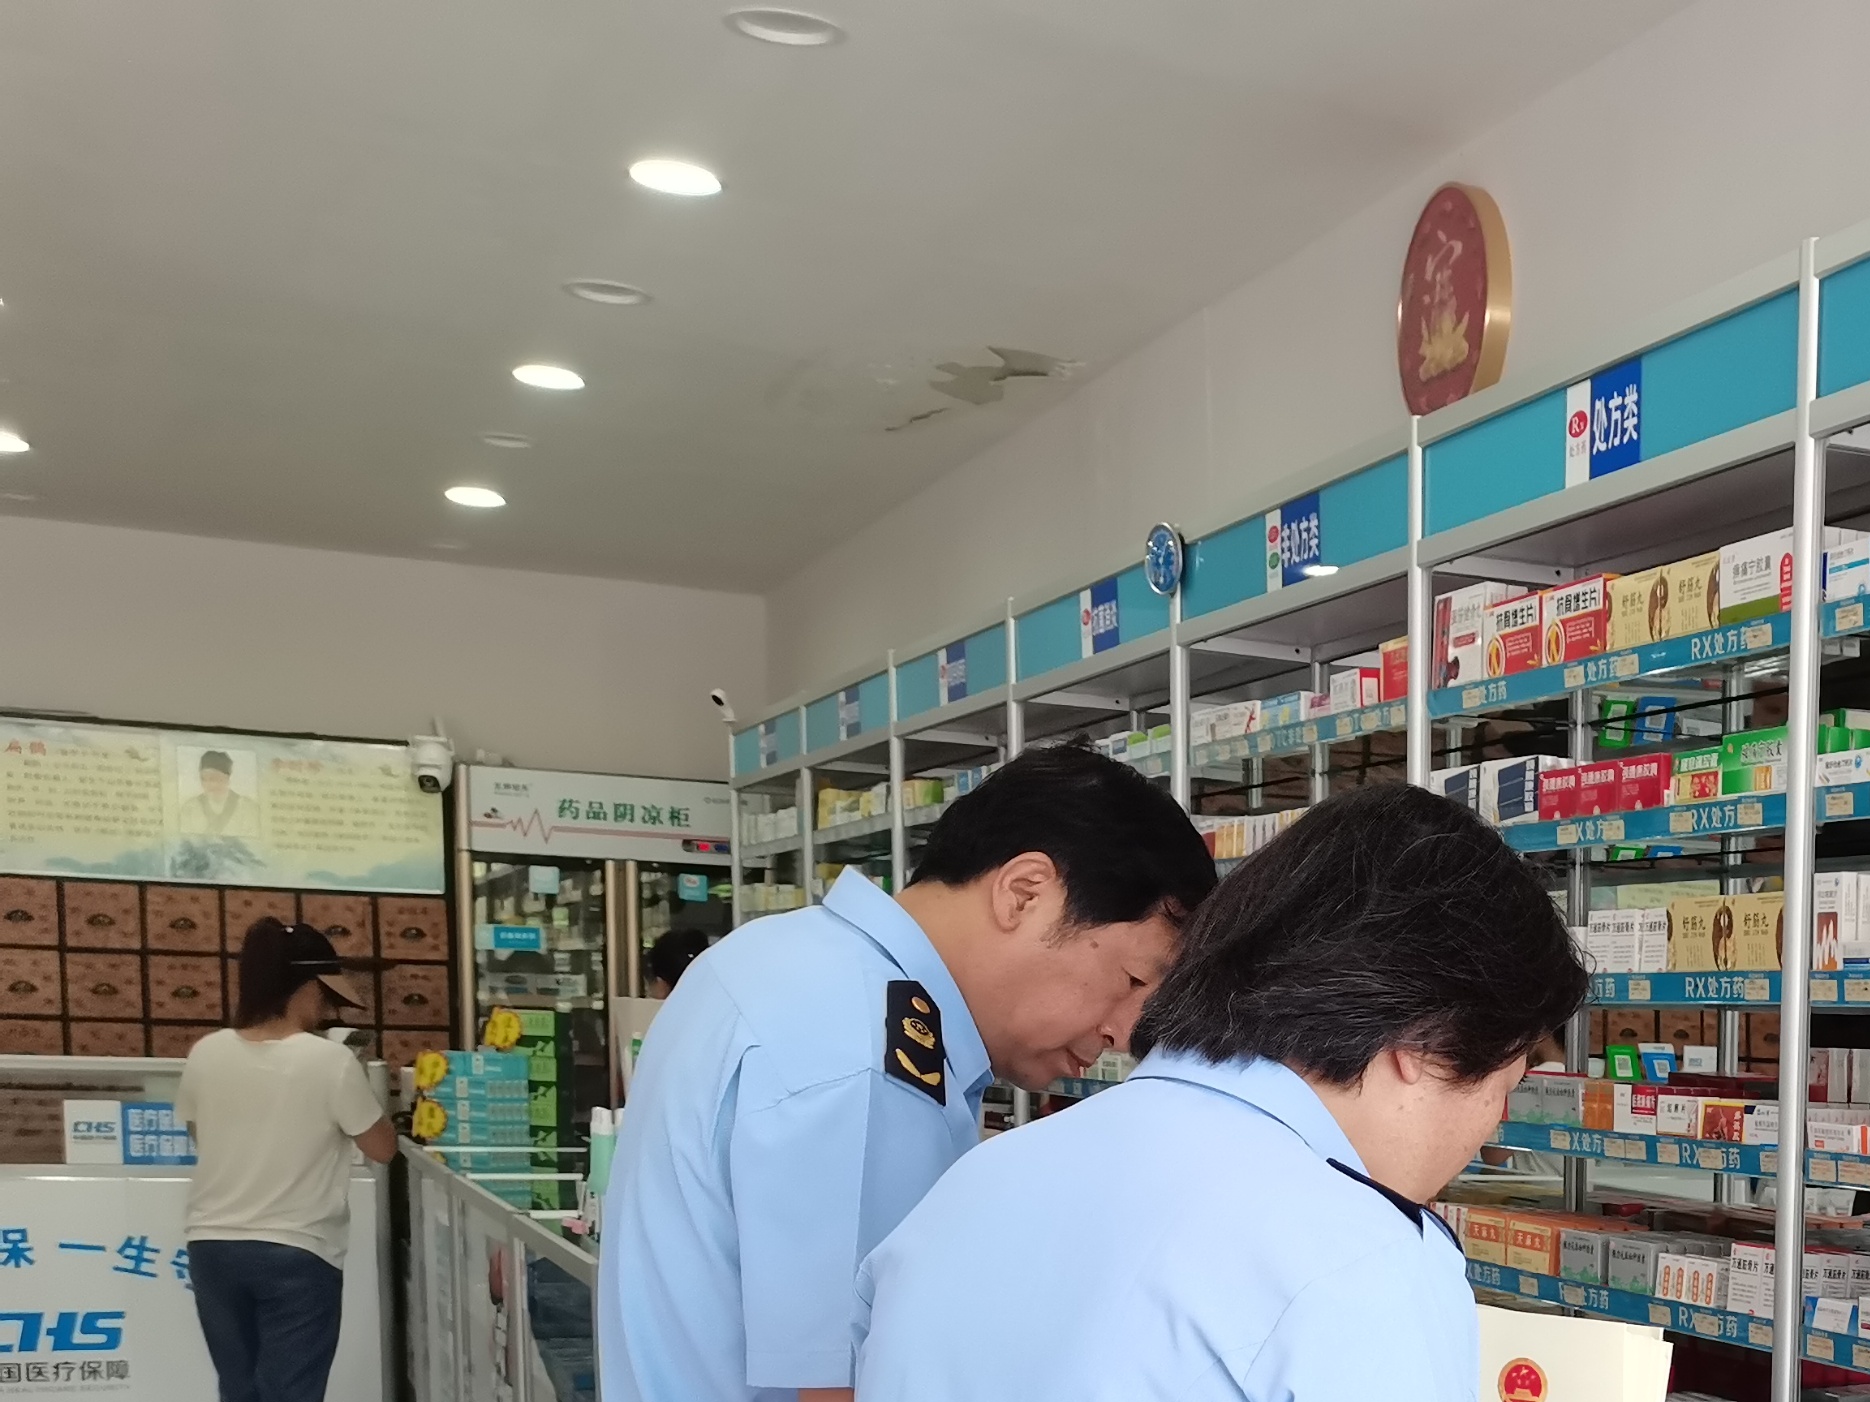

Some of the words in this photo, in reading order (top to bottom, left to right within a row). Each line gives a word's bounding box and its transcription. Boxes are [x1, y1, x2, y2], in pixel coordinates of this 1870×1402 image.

[1592, 383, 1639, 457] 处方类
[556, 797, 692, 828] 药品阴凉柜
